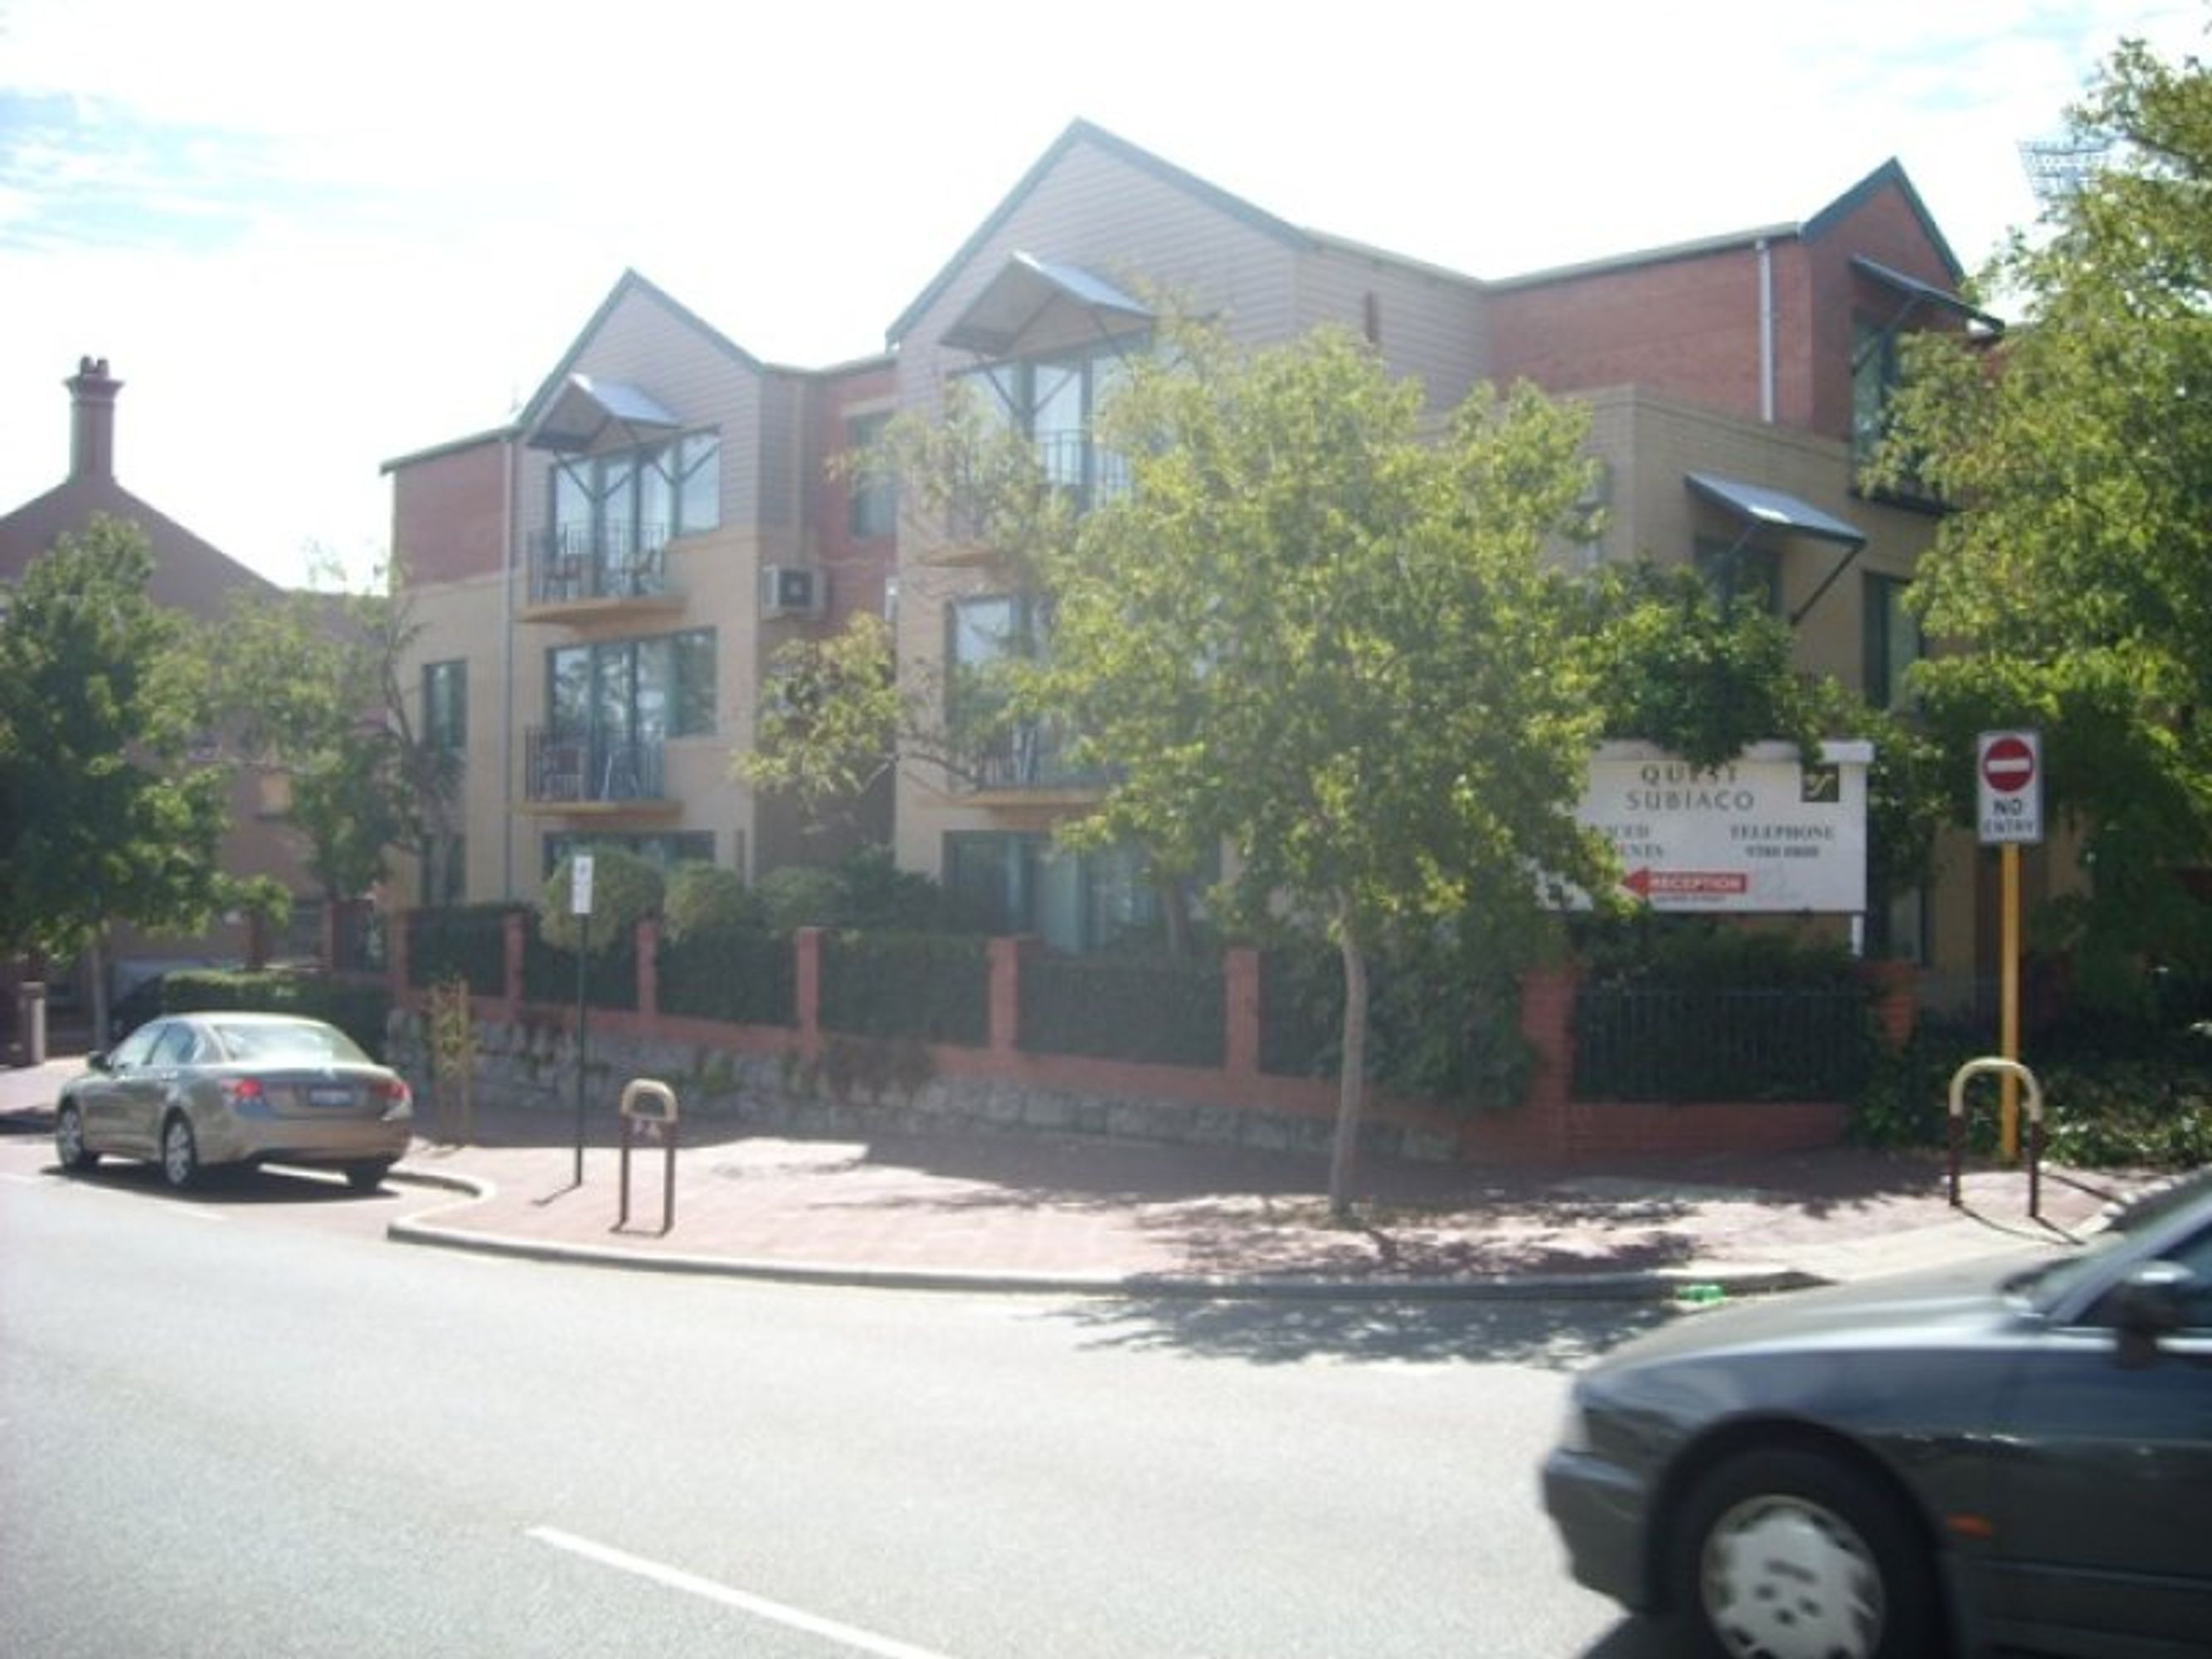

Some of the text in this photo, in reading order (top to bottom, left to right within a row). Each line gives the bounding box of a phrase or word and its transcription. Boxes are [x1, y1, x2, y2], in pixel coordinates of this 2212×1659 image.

[1641, 762, 1738, 786] QUEST
[1625, 790, 1754, 810] SUBIACO
[1993, 799, 2022, 815] NO
[1730, 825, 1835, 840] TELEPHONE
[1984, 820, 2033, 833] ENTRY
[1649, 875, 1740, 890] RECEPTION
